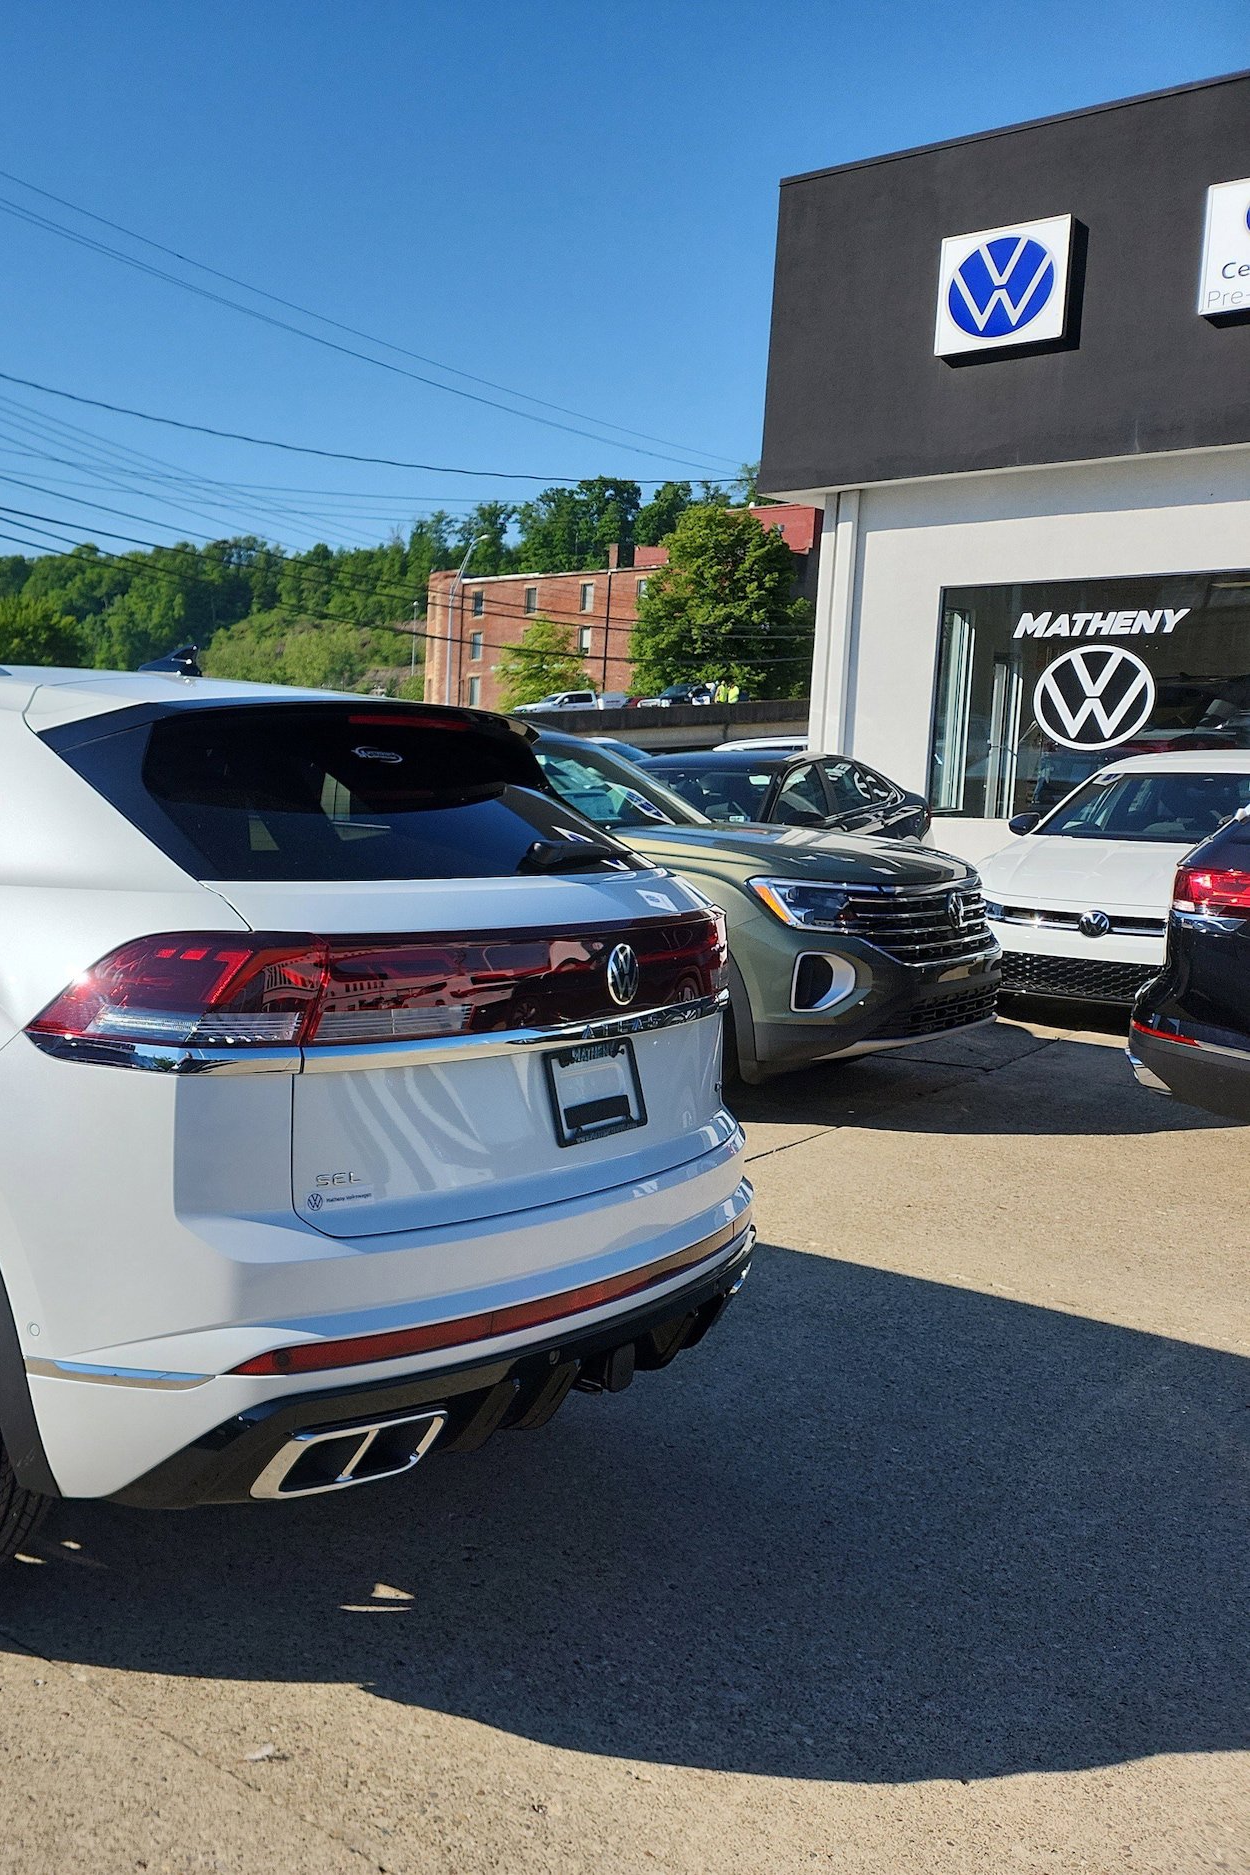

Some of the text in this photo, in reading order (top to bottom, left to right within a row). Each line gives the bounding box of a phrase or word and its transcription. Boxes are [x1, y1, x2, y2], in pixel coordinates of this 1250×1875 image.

[947, 234, 1056, 338] VW
[1012, 608, 1192, 639] MATHENY
[1035, 646, 1153, 748] VW
[315, 1171, 362, 1187] SEL
